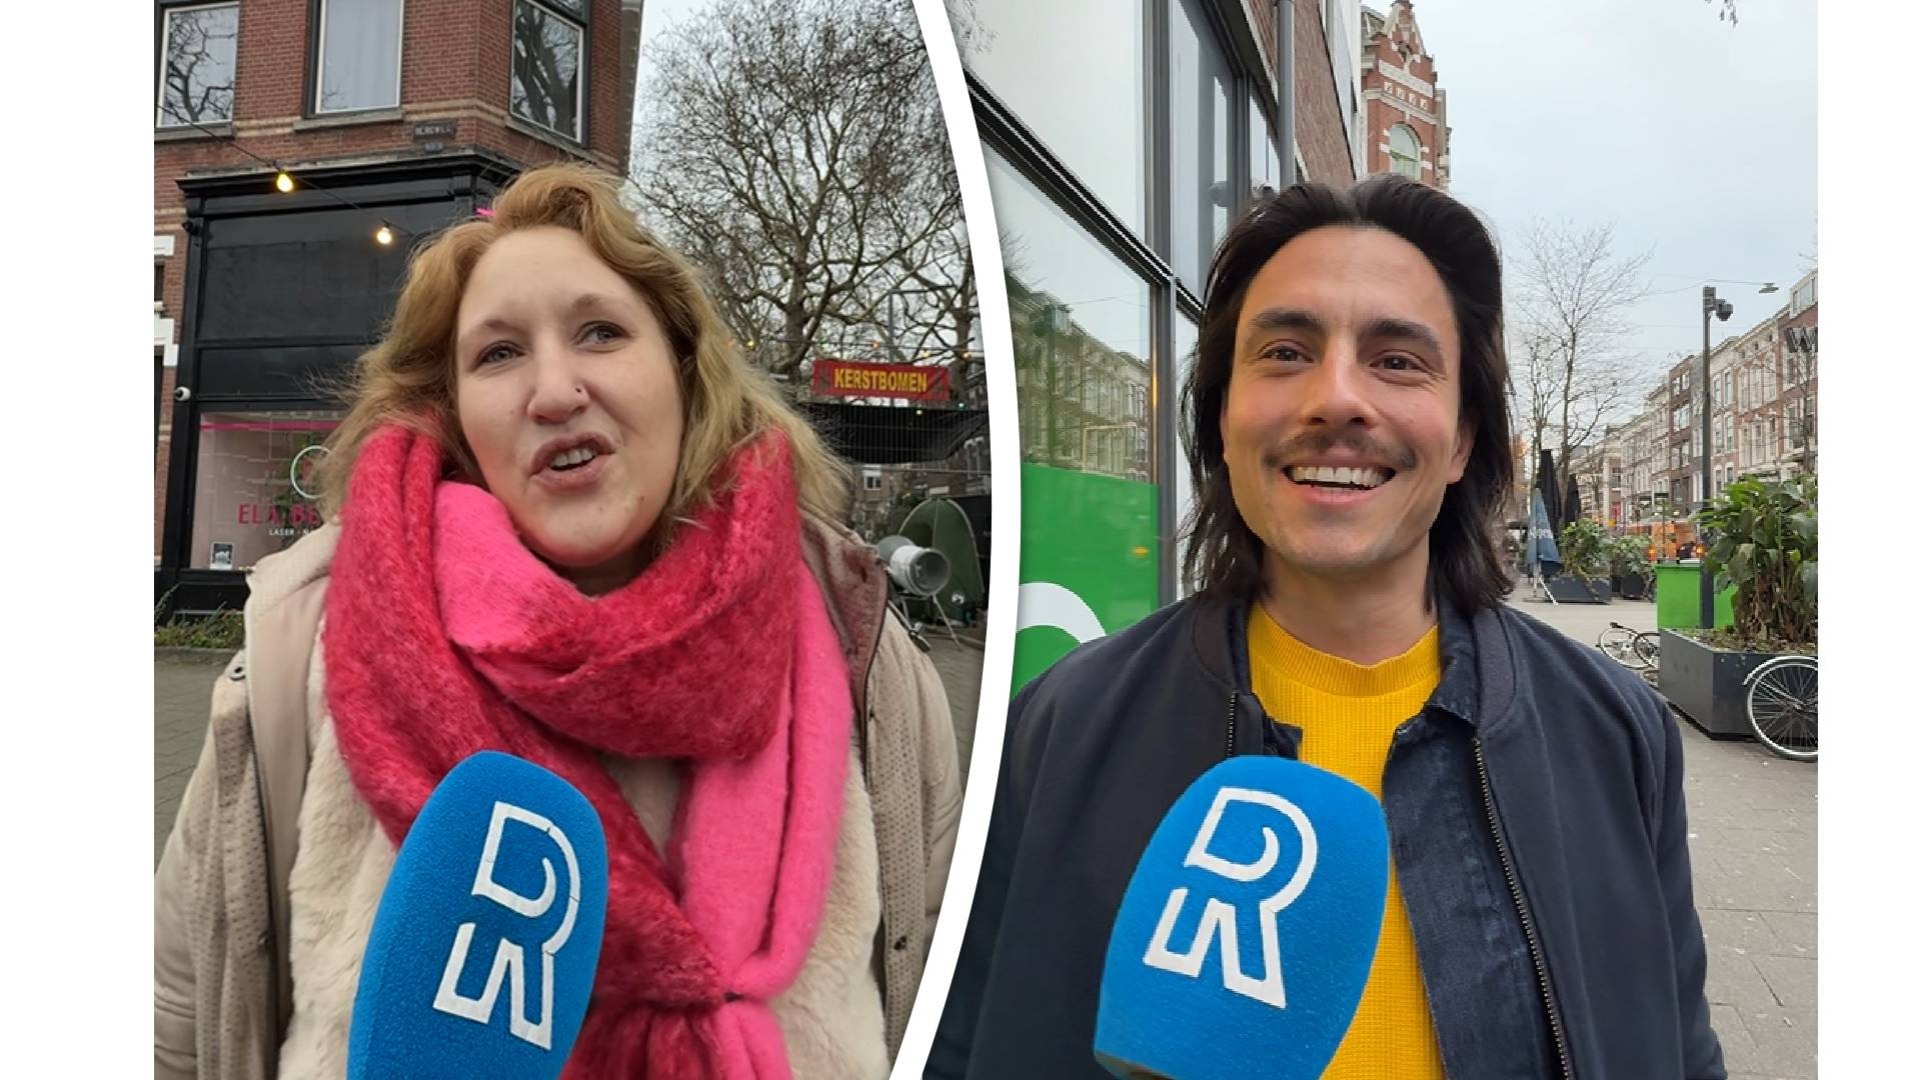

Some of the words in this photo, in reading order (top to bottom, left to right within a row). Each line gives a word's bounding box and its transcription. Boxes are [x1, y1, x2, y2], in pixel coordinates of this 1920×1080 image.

[833, 367, 928, 393] KERSTBOMEN
[238, 503, 284, 526] ELA
[268, 528, 295, 536] LASER
